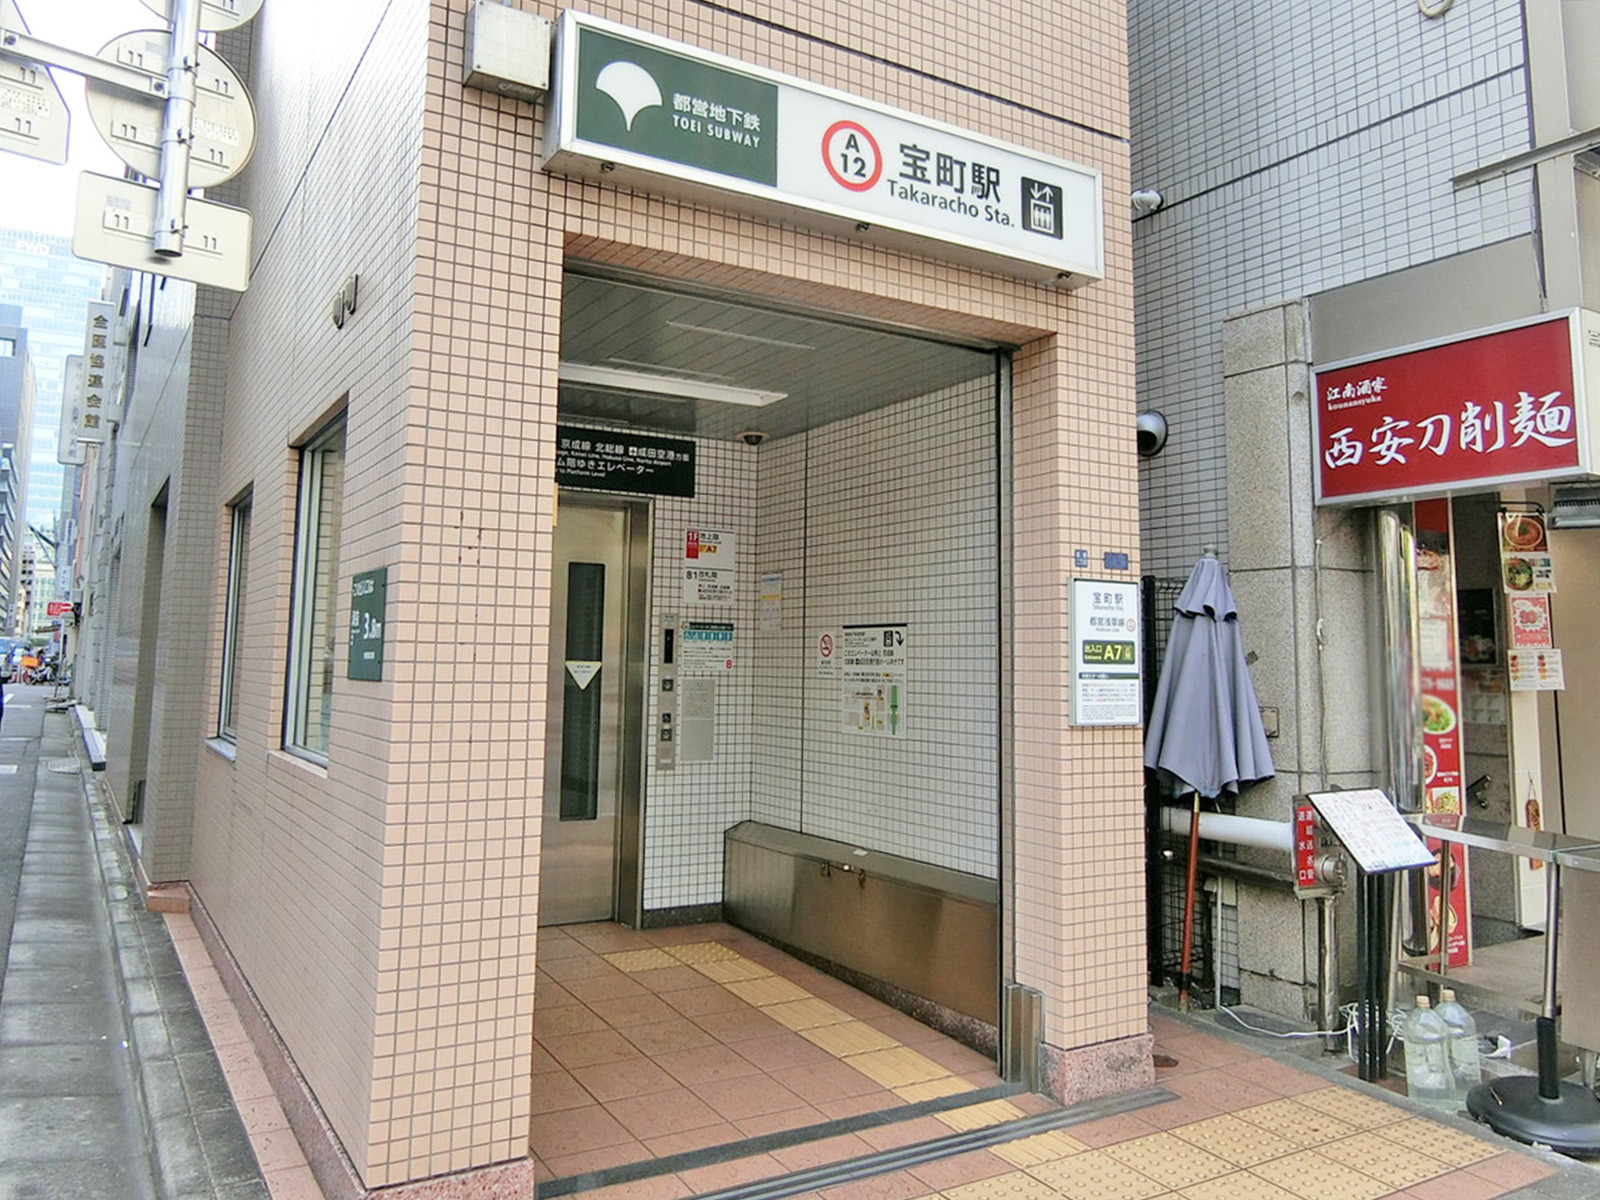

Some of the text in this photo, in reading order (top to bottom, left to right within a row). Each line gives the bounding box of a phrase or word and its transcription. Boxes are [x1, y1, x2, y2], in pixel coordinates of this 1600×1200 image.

[673, 93, 761, 132] 都営地下鉄
[673, 115, 761, 149] TOEI SUBWAY
[845, 133, 860, 153] A
[840, 152, 867, 178] 12
[899, 143, 1001, 203] 宝町駅
[887, 178, 1015, 228] Takaracho Sta.
[1326, 376, 1388, 401] 江南酒家
[1324, 390, 1576, 470] 西安刀削麺
[1103, 644, 1123, 661] A7
